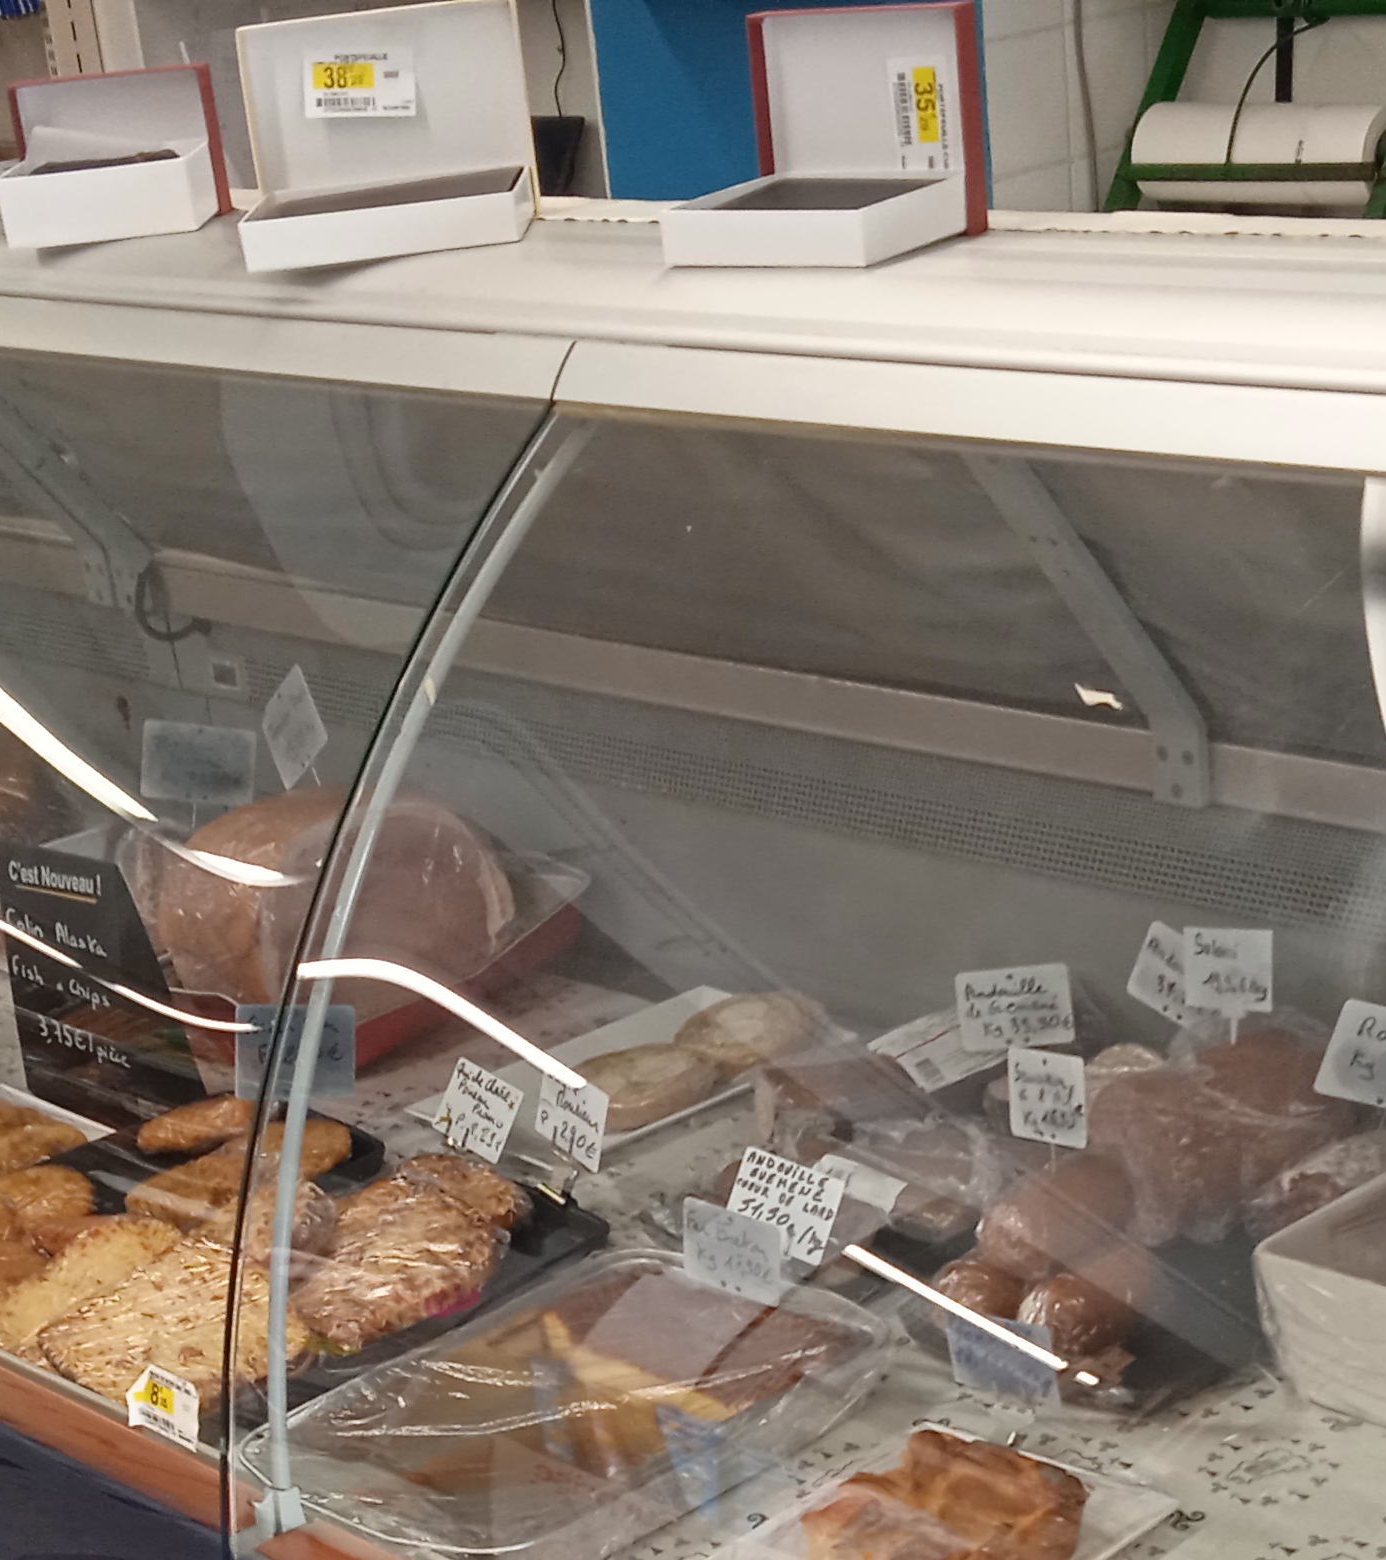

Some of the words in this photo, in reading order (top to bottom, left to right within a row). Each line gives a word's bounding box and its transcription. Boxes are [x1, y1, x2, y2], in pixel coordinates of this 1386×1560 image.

[8, 860, 39, 885] C'est
[40, 865, 94, 894] Nouveau
[54, 921, 108, 958] Alaska
[12, 954, 45, 986] Fish
[68, 978, 111, 1010] Chips
[746, 1151, 830, 1190] ANDOUILLE
[802, 1202, 835, 1222] LARD
